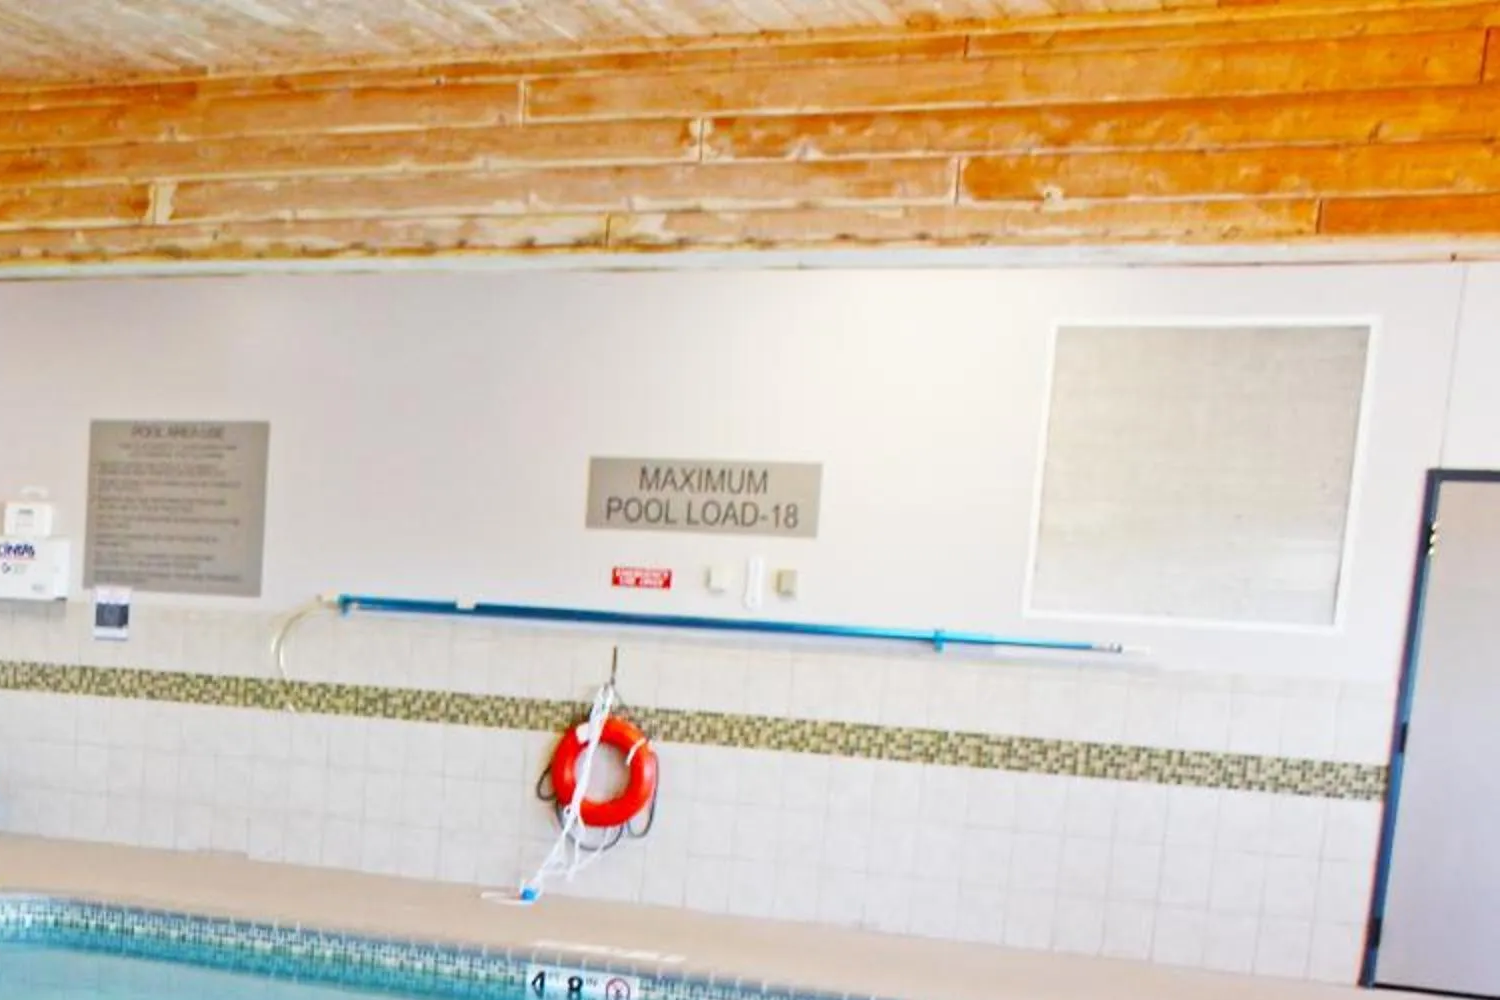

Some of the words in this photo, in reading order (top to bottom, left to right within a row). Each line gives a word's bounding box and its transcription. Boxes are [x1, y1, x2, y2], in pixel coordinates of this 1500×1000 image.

[639, 466, 768, 495] MAXIMUM
[606, 497, 677, 524] POOL
[686, 500, 799, 529] LOAD-18
